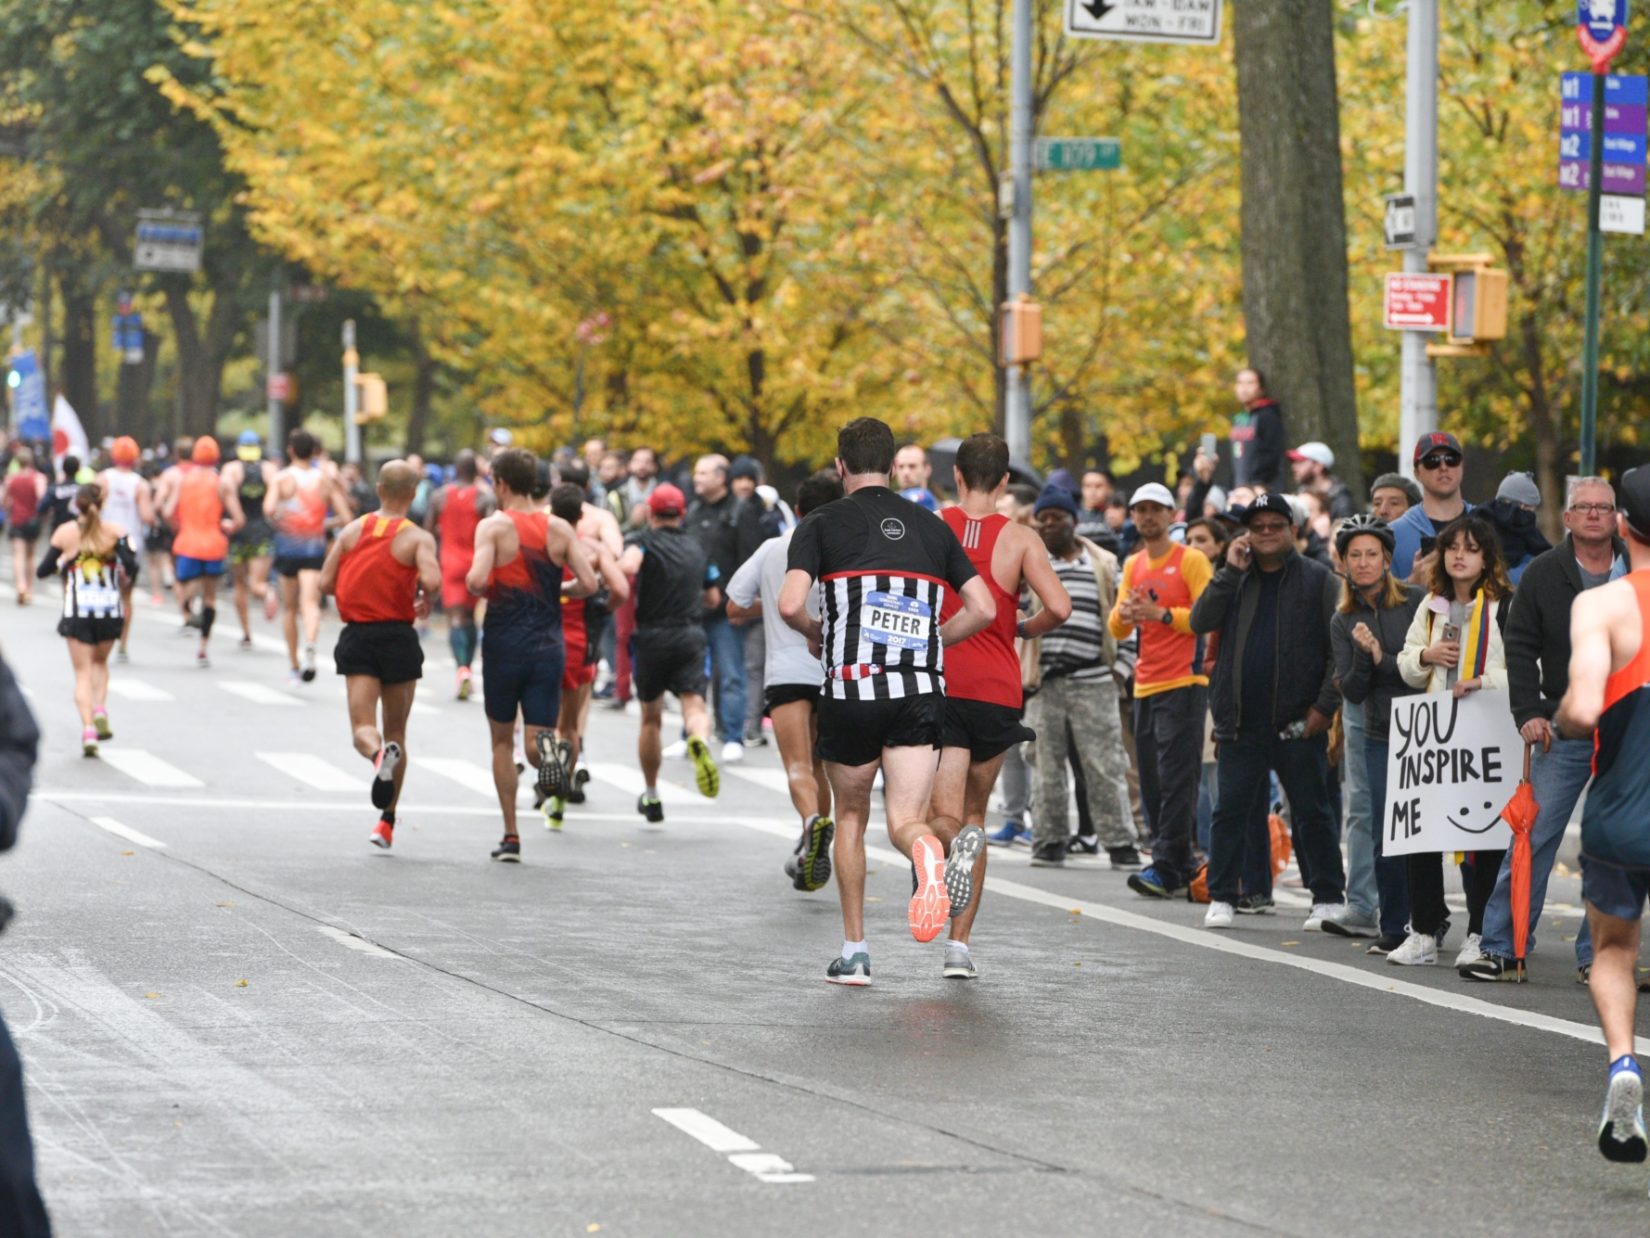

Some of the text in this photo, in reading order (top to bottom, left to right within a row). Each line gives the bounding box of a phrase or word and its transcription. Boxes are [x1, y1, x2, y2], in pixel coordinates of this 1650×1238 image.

[1125, 14, 1162, 27] MON
[1178, 16, 1206, 30] FRI
[871, 610, 921, 635] PETER
[887, 635, 906, 645] 2017
[1395, 700, 1458, 760] YOU
[1399, 747, 1502, 790] INSPIRE
[1391, 798, 1421, 841] ME
